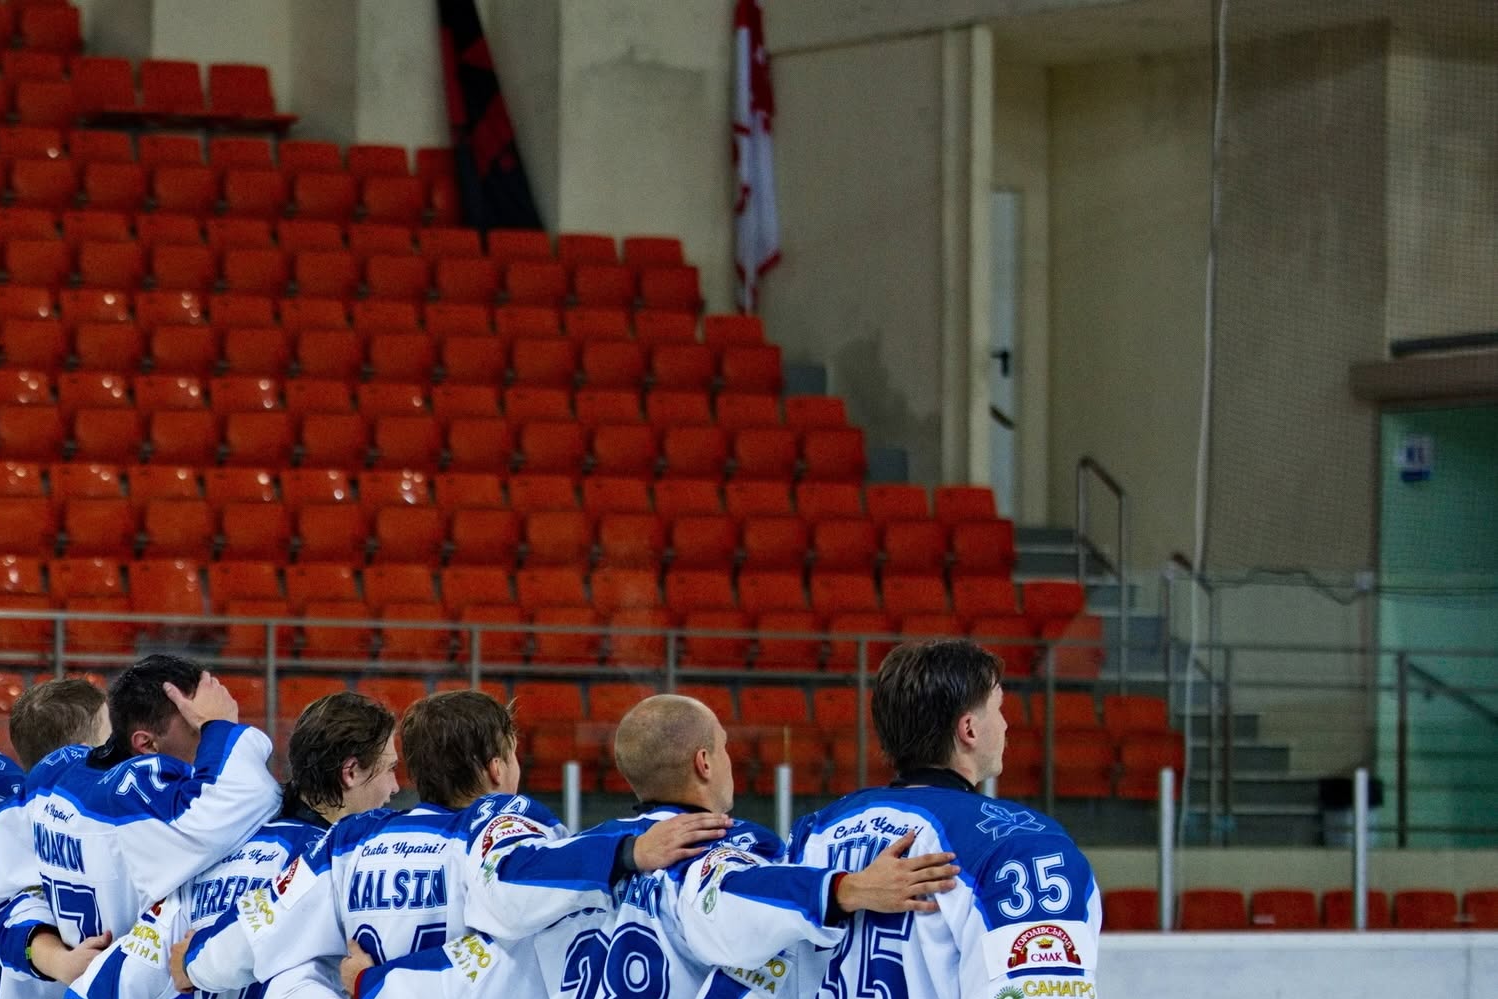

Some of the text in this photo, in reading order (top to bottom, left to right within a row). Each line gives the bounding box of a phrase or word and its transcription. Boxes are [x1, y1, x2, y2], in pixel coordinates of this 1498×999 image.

[361, 843, 447, 858] Слава Україні!
[995, 852, 1073, 920] 35
[1030, 952, 1064, 963] СМАК
